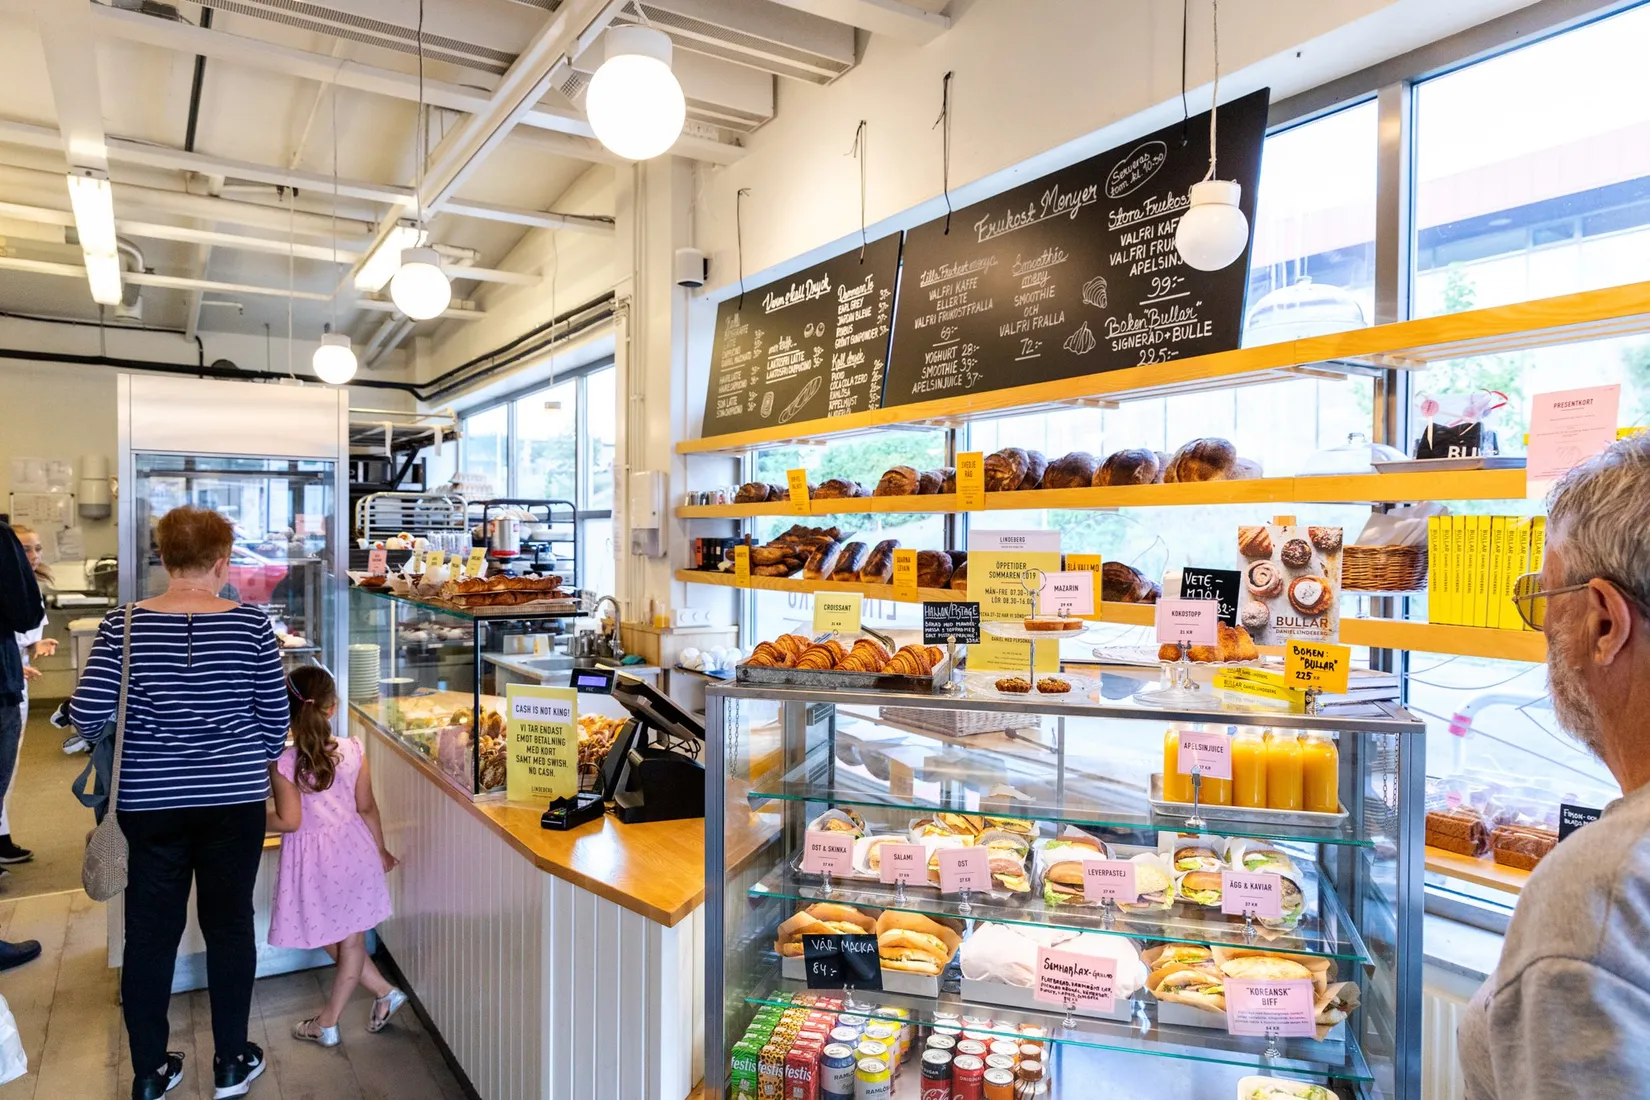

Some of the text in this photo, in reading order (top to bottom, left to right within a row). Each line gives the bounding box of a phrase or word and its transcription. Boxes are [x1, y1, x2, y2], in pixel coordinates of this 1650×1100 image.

[1112, 153, 1150, 185] Serveras
[974, 183, 1097, 243] Frukost Menyer
[1108, 207, 1144, 229] Stora
[1120, 217, 1179, 247] VALFRI KAF
[1012, 246, 1069, 274] Smoothie
[1109, 244, 1146, 266] VALFRI
[1129, 253, 1183, 277] APELSINJ
[805, 272, 831, 300] Dryck
[1021, 270, 1051, 288] meny
[929, 277, 979, 301] VALFRI KAFFE
[1147, 276, 1185, 298] 99:-
[1014, 285, 1056, 307] SMOOTHIE
[914, 298, 993, 329] VALFRI FRUKOSTFRALLA
[999, 311, 1065, 337] VALFRI FRALLA
[1104, 313, 1147, 339] Boken
[1020, 337, 1042, 355] 72:-
[925, 343, 980, 365] YOGHURT 28:-
[1137, 348, 1179, 367] 225:-
[921, 358, 978, 379] SMOOTHIE 39:-
[911, 375, 962, 394] APELSINJUICE
[1553, 398, 1593, 409] PRESENTKORT
[964, 469, 973, 478] RÅG
[996, 561, 1027, 570] ÖPPETIDER
[989, 571, 1020, 579] SOMMAREN
[985, 587, 1008, 596] MÅN-FRE
[991, 596, 1001, 604] LÖR
[1171, 610, 1201, 618] KOKOSTOPP
[1276, 616, 1328, 628] BULLAR
[1296, 671, 1313, 680] 225
[1224, 679, 1242, 688] BULLAR
[515, 704, 570, 717] CASH IS NOT KING!
[527, 724, 539, 733] TAR
[540, 725, 563, 735] ENDAST
[516, 734, 566, 746] EMOT BETALNING
[1183, 742, 1224, 753] APELSINJUICE
[526, 745, 556, 756] MED KORT
[515, 755, 569, 768] SAMT MED SWISH.
[528, 767, 556, 777] NO CASH.
[827, 845, 847, 854] SKINKA
[894, 853, 913, 861] SALAMI
[1088, 868, 1126, 877] LEVERPASTEJ
[1230, 880, 1272, 892] ÄGG & KAVIAR
[811, 938, 876, 953] VÅR MACKA
[1262, 998, 1278, 1006] BIFF
[731, 1056, 757, 1072] festis
[757, 1061, 784, 1077] festis
[785, 1064, 812, 1081] festis
